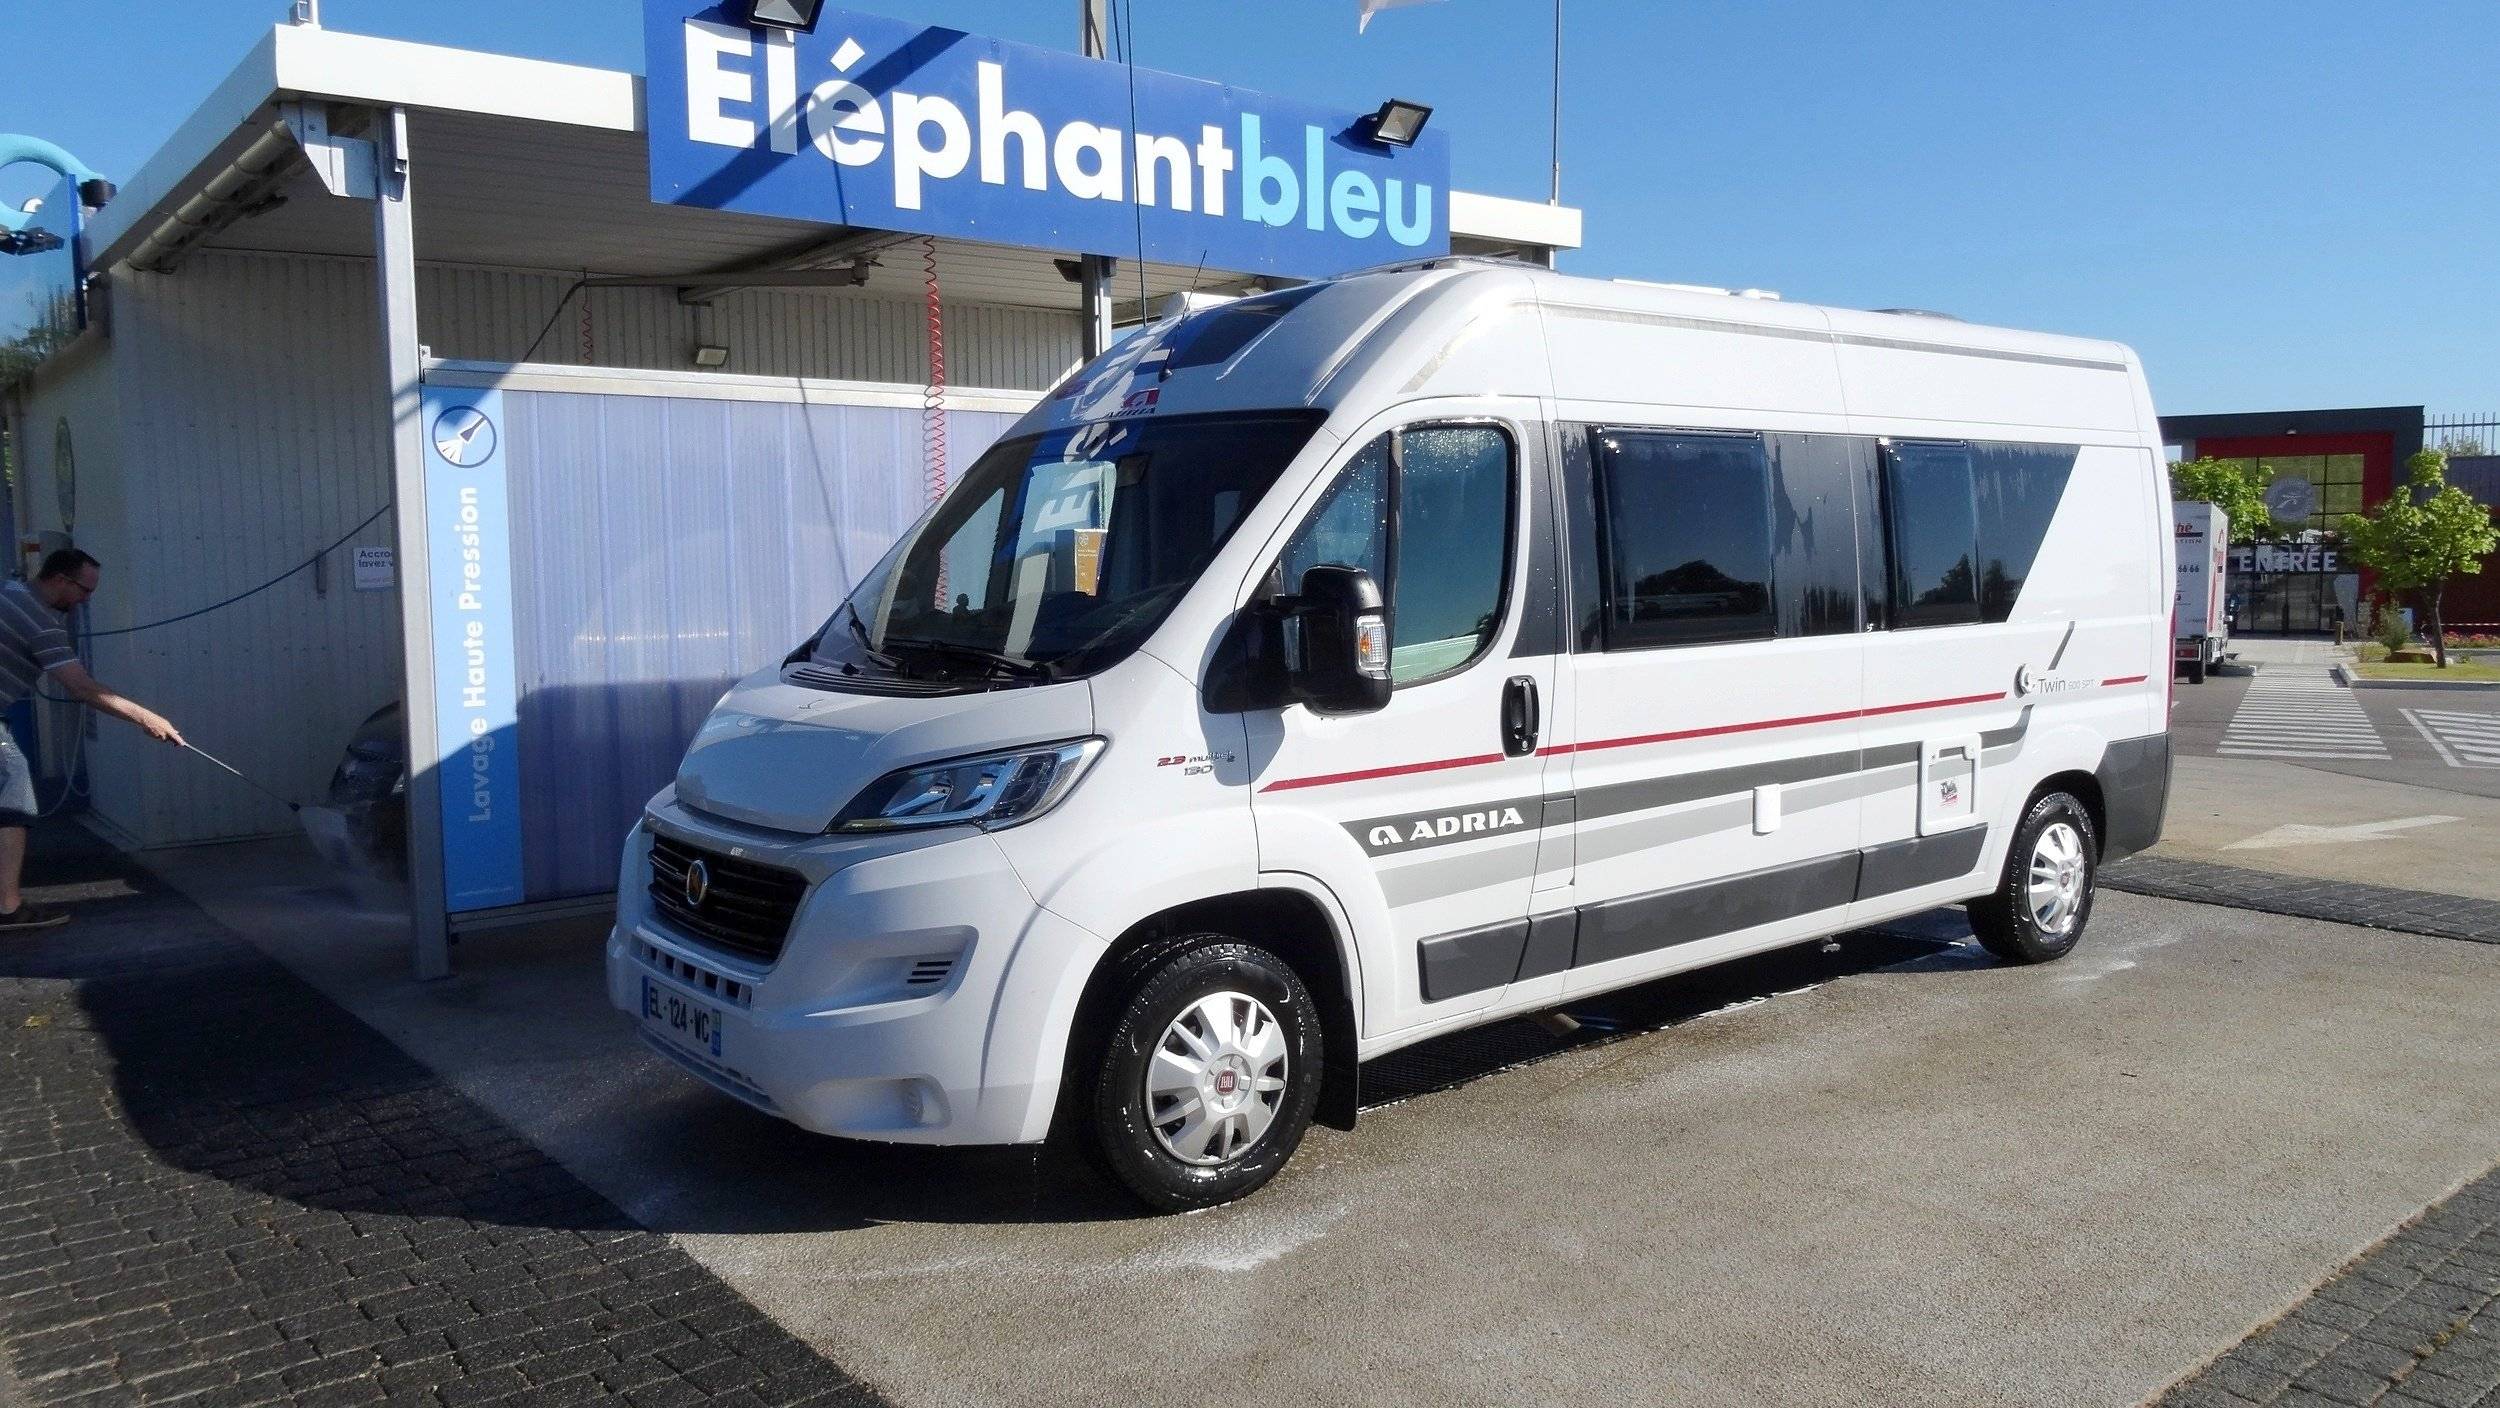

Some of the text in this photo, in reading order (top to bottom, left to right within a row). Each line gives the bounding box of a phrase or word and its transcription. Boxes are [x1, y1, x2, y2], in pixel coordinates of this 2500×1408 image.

[359, 550, 392, 558] Accro
[454, 486, 495, 822] Lavage Haute Pression
[2038, 677, 2066, 694] Twin
[1157, 756, 1186, 767] 2.3
[1184, 765, 1213, 776] 130
[1409, 807, 1524, 842] ADRIA
